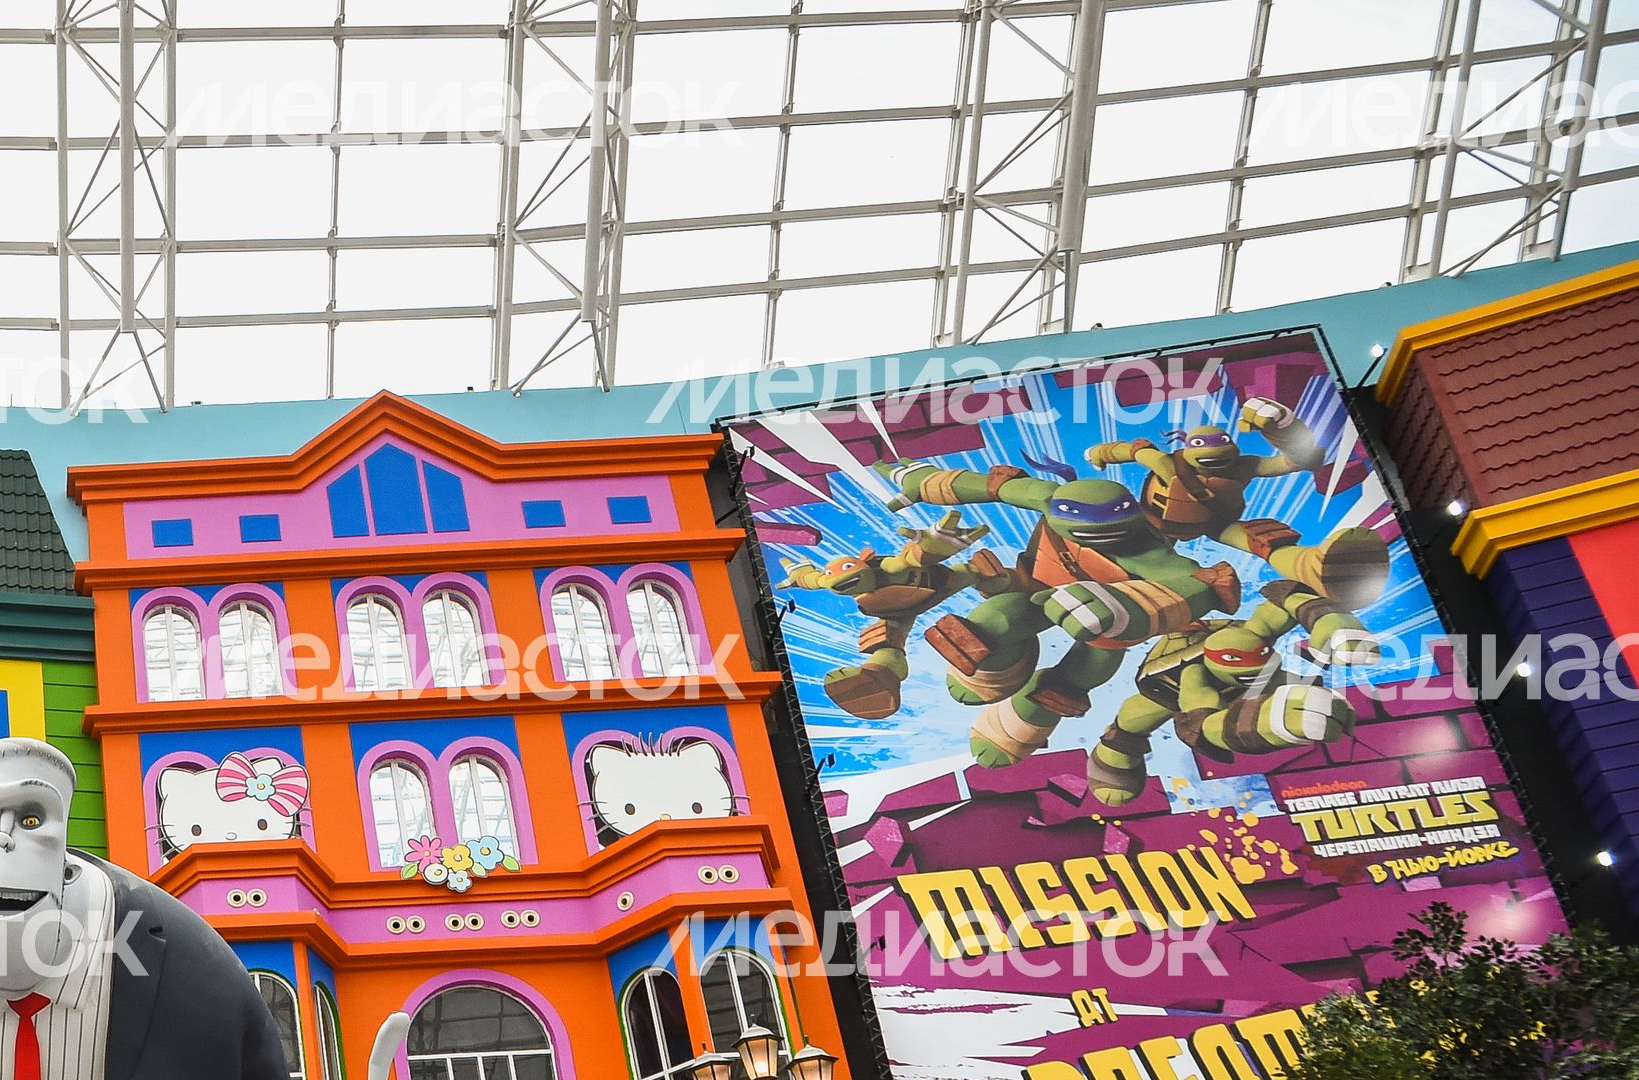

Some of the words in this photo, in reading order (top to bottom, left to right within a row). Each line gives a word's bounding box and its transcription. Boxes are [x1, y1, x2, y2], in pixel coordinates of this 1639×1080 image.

[1282, 780, 1368, 798] nickelodeon
[1284, 792, 1356, 812] TEENAGE
[1358, 783, 1430, 803] MUTANT
[1432, 776, 1487, 796] NINJA
[1290, 791, 1500, 842] TURTLES
[1312, 824, 1502, 858] ЧЕРЕПАШКИ-НИНДЗЯ
[896, 846, 1258, 960] MISSION
[1070, 987, 1119, 1028] AT
